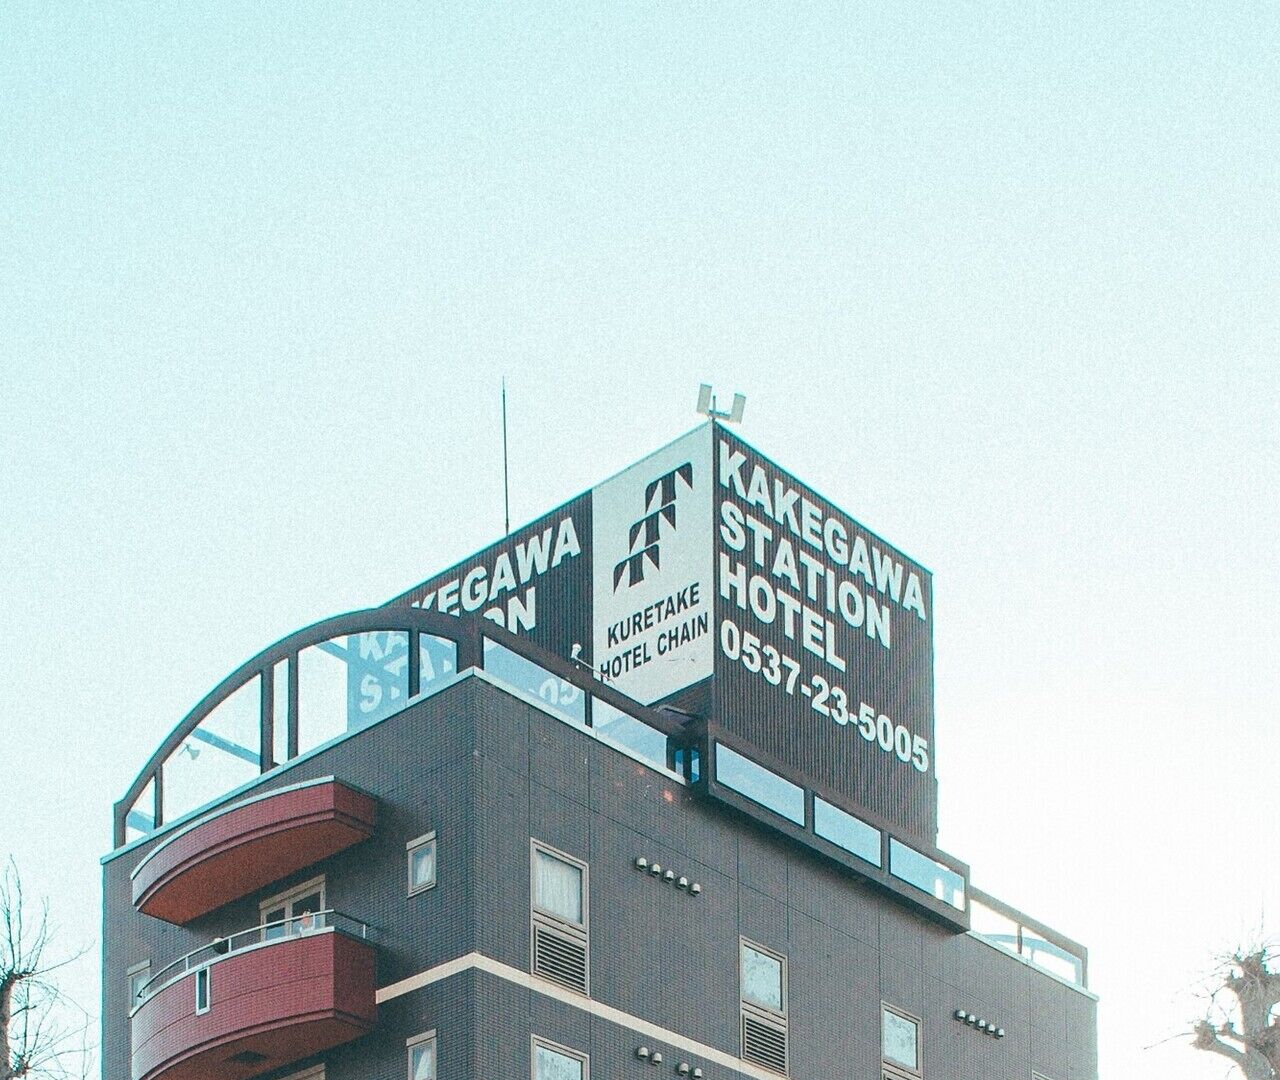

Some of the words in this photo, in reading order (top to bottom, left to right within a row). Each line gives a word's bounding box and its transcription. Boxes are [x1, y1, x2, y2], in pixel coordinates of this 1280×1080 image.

[720, 439, 926, 621] KAKEGAWA
[720, 501, 890, 649] STATION
[600, 642, 651, 682] HOTEL
[657, 612, 708, 656] CHAIN
[607, 582, 700, 648] KURETAKE
[720, 552, 846, 673] HOTEL
[720, 619, 928, 773] 0537-23-5005
